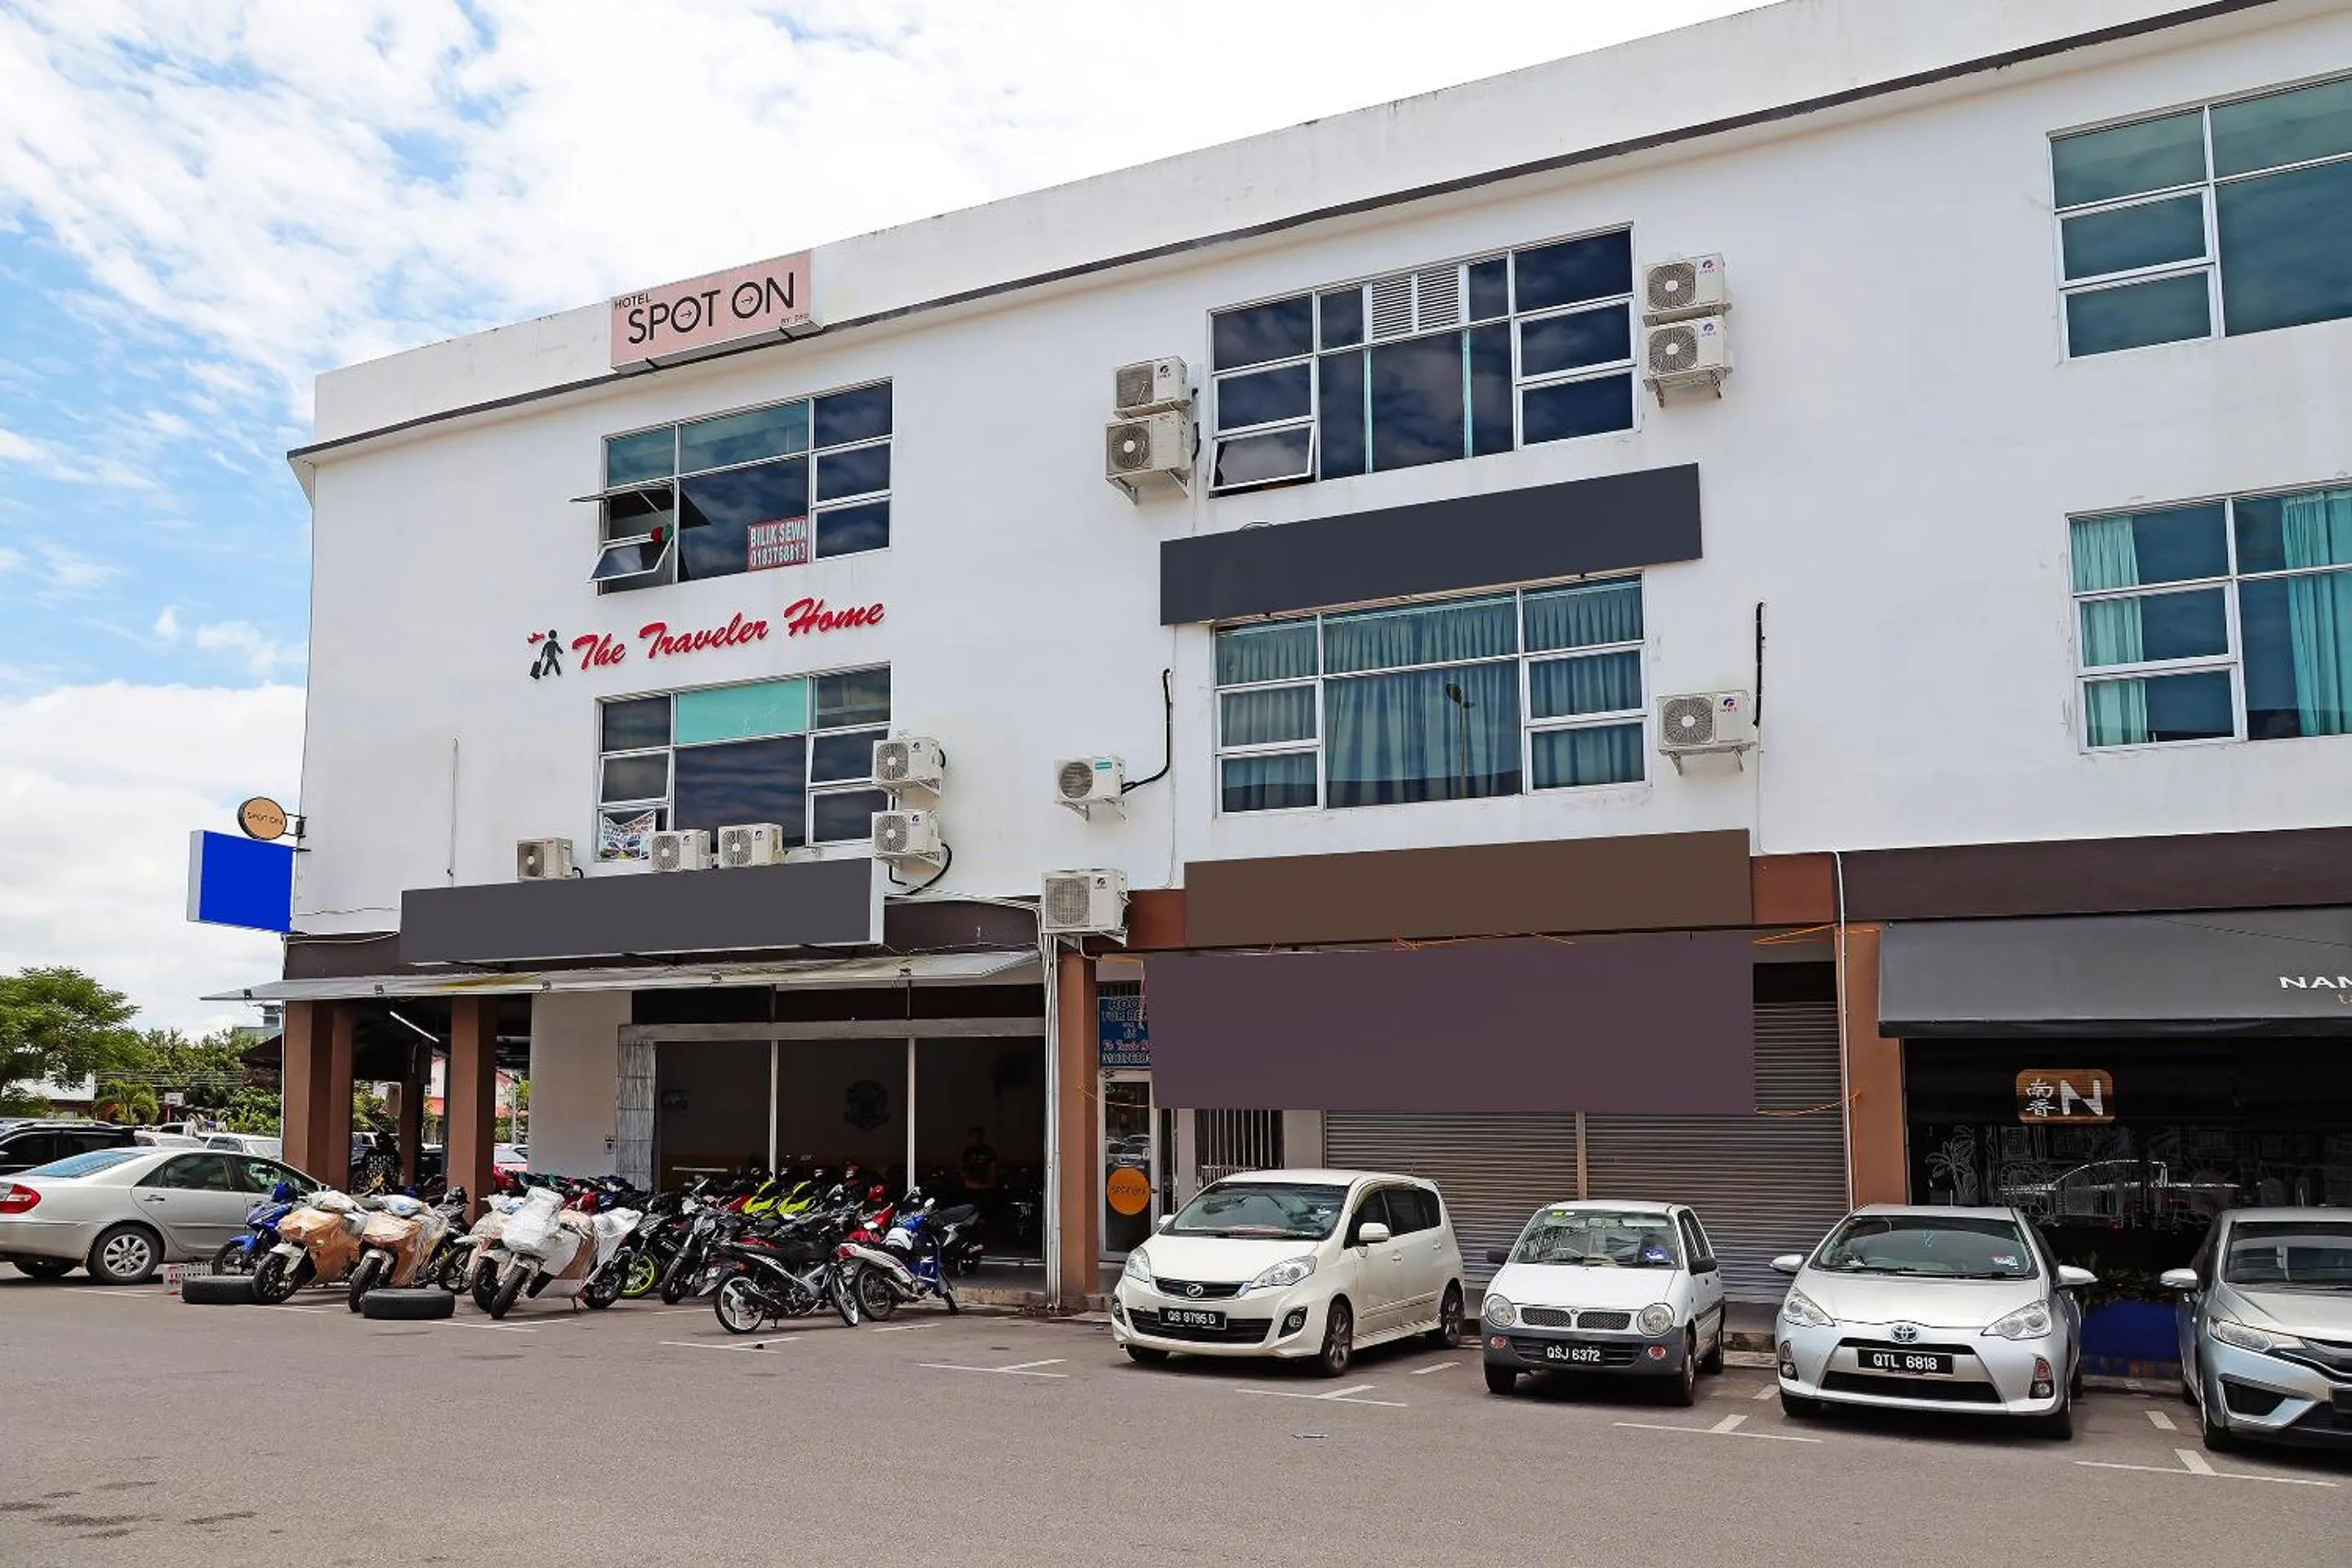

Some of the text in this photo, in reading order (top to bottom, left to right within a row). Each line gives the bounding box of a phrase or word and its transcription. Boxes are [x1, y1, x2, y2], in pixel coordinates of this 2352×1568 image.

[614, 292, 652, 310] HOTEL
[628, 272, 795, 345] SPOT ON
[778, 520, 807, 543] SEWA
[572, 597, 885, 671] The Traveler Home
[1209, 1313, 1216, 1324] D
[1547, 1344, 1601, 1362] QSJ 6372
[1873, 1352, 1937, 1370] QTL 6818
